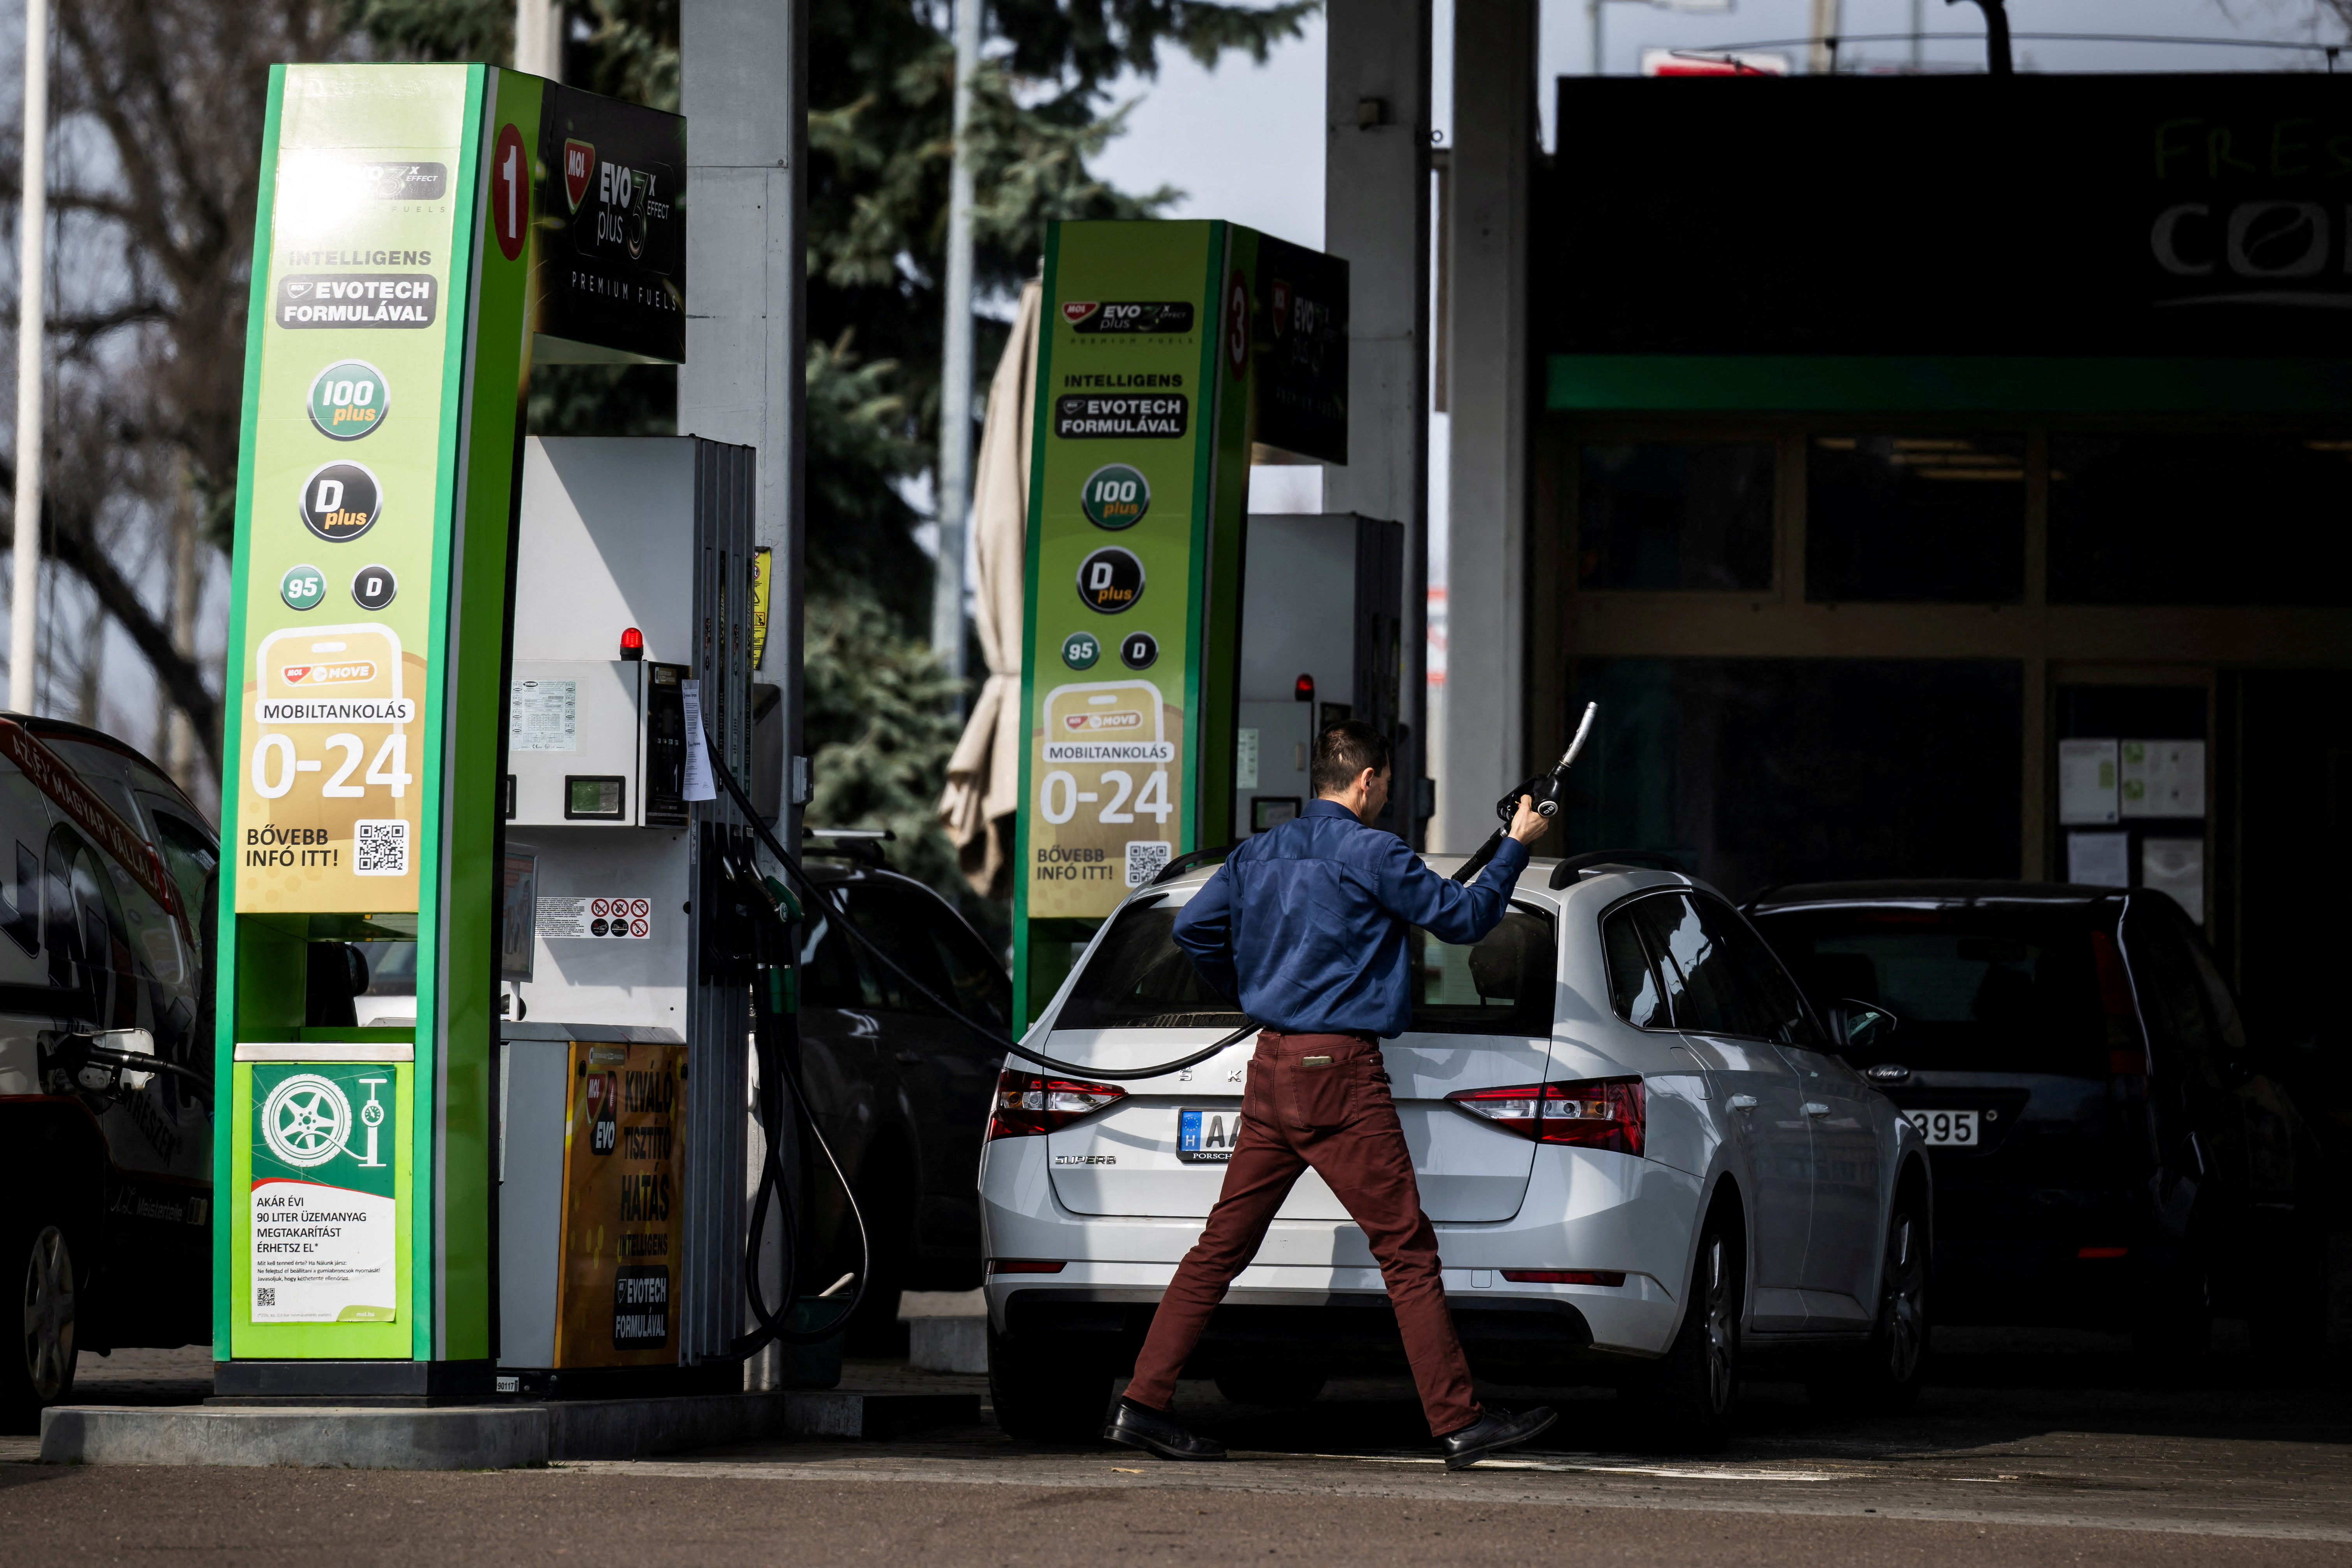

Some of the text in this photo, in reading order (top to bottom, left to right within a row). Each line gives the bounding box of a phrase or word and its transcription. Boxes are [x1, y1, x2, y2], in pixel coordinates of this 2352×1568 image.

[568, 150, 585, 178] MOL
[503, 145, 516, 238] 1
[600, 161, 631, 208] EVO
[647, 200, 669, 220] EFFECT
[597, 202, 623, 246] plus
[2150, 199, 2352, 277] CO
[289, 251, 431, 265] INTELLIGENS
[316, 282, 429, 299] EVOTECH
[572, 271, 676, 311] PREMIUM FUELS
[284, 301, 428, 322] FORMULÁVAL
[1067, 305, 1086, 313] MOL
[1103, 304, 1141, 318] EVO
[1100, 317, 1130, 331] plus
[1232, 285, 1245, 364] 3
[1065, 375, 1182, 387] INTELLIGENS
[323, 380, 374, 406] 100
[333, 404, 376, 426] plus
[1087, 399, 1181, 415] EVOTECH
[1062, 415, 1180, 433] FORMULÁVAL
[315, 479, 344, 512] D
[1095, 480, 1137, 503] 100
[324, 509, 366, 529] plus
[1103, 502, 1139, 518] plus
[1090, 562, 1113, 590] D
[288, 577, 318, 598] 95
[366, 577, 382, 597] D
[1097, 586, 1132, 603] plus
[1069, 642, 1093, 660] 95
[1133, 642, 1146, 659] D
[329, 666, 370, 678] MOVE
[264, 701, 407, 719] MOBILTANKOLÁS
[1103, 714, 1136, 726] MOVE
[1049, 744, 1167, 759] MOBILTANKOLÁS
[251, 732, 413, 799] 0-24
[1040, 770, 1173, 824] 0-24
[13, 734, 163, 899] AZ ÉV MAGYAR VÁLLALA
[247, 824, 328, 845] BŐVEBB
[246, 845, 338, 866] INFÓ ITT!
[1038, 845, 1104, 862] BŐVEBB
[1037, 862, 1113, 880] INFÓ ITT!
[1877, 1068, 1899, 1076] Ford
[588, 1079, 600, 1098] MOL
[625, 1060, 673, 1113] KIVÁLÓ
[595, 1121, 615, 1149] EVO
[624, 1117, 671, 1160] TISZTÍTÓ
[1186, 1135, 1195, 1146] H
[1055, 1156, 1116, 1165] SUPERB
[257, 1195, 303, 1207] AKÁR ÉVI
[621, 1162, 669, 1221] HATÁS
[136, 1197, 182, 1222] Meisterteile
[257, 1211, 366, 1222] 90 LITER ÜZEMANYAG
[257, 1225, 341, 1237] MEGTAKARÍTÁST
[257, 1241, 300, 1253] ÉRHETSZ
[619, 1234, 668, 1256] INTELLIGENS
[627, 1278, 666, 1303] EVOTECH
[616, 1306, 665, 1338] FORMULÁVAL
